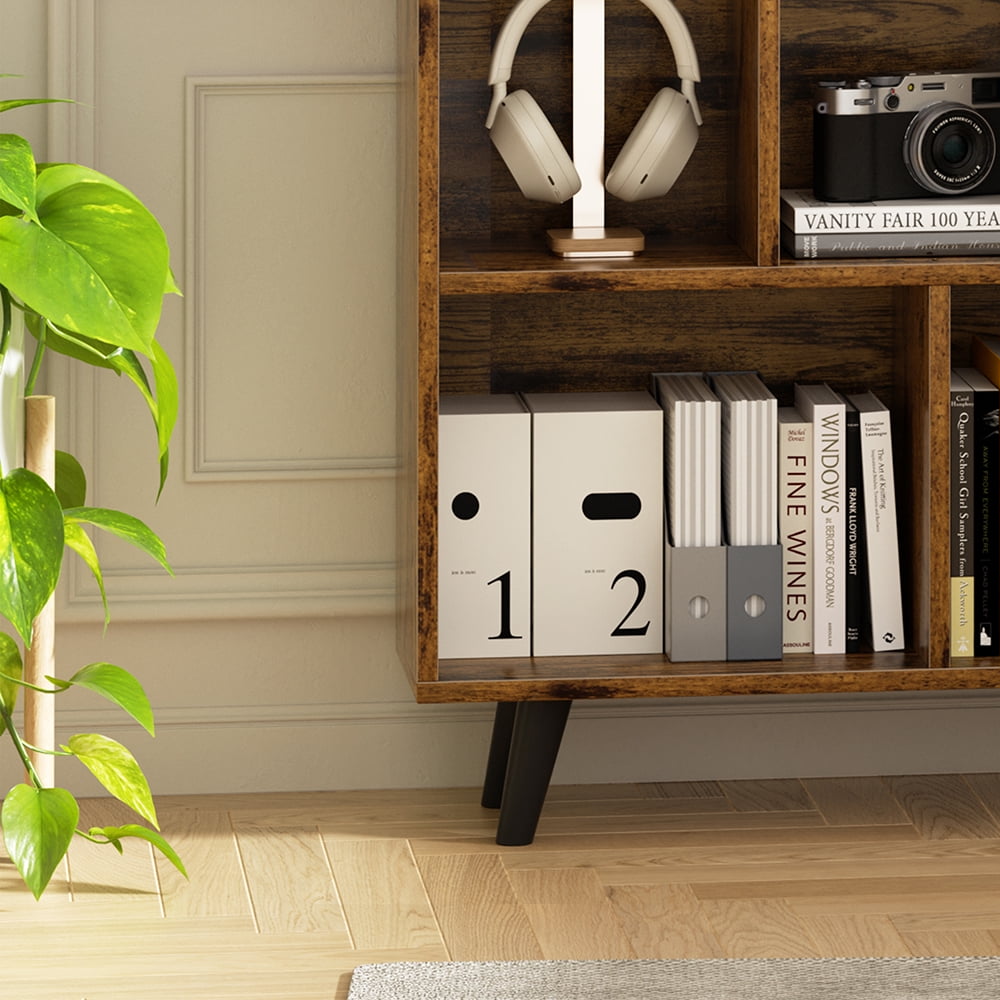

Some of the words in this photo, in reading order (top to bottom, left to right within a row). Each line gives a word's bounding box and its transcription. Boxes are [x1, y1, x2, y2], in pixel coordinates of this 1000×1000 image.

[805, 212, 877, 230] VANITY
[883, 212, 924, 228] FAIR
[931, 211, 959, 228] 100
[832, 240, 870, 252] Public
[880, 241, 906, 252] and
[914, 240, 960, 252] Indian
[958, 412, 969, 448] Quaker
[821, 412, 840, 514] WINDOWS
[878, 462, 886, 473] Art
[958, 451, 969, 484] School
[982, 446, 990, 468] AWAY
[786, 456, 807, 516] FINE
[958, 487, 969, 510] Girl
[982, 470, 990, 494] FROM
[849, 488, 858, 514] FRANK
[825, 525, 835, 566] BERGDORF
[849, 516, 858, 542] LLOYD
[957, 512, 969, 555] Samplers
[786, 530, 807, 622] WINES
[849, 543, 858, 576] WRIGHT
[958, 557, 968, 577] from
[610, 569, 651, 637] 2
[825, 566, 835, 608] GOODMAN
[958, 580, 969, 627] Ackworth
[487, 570, 523, 640] 1
